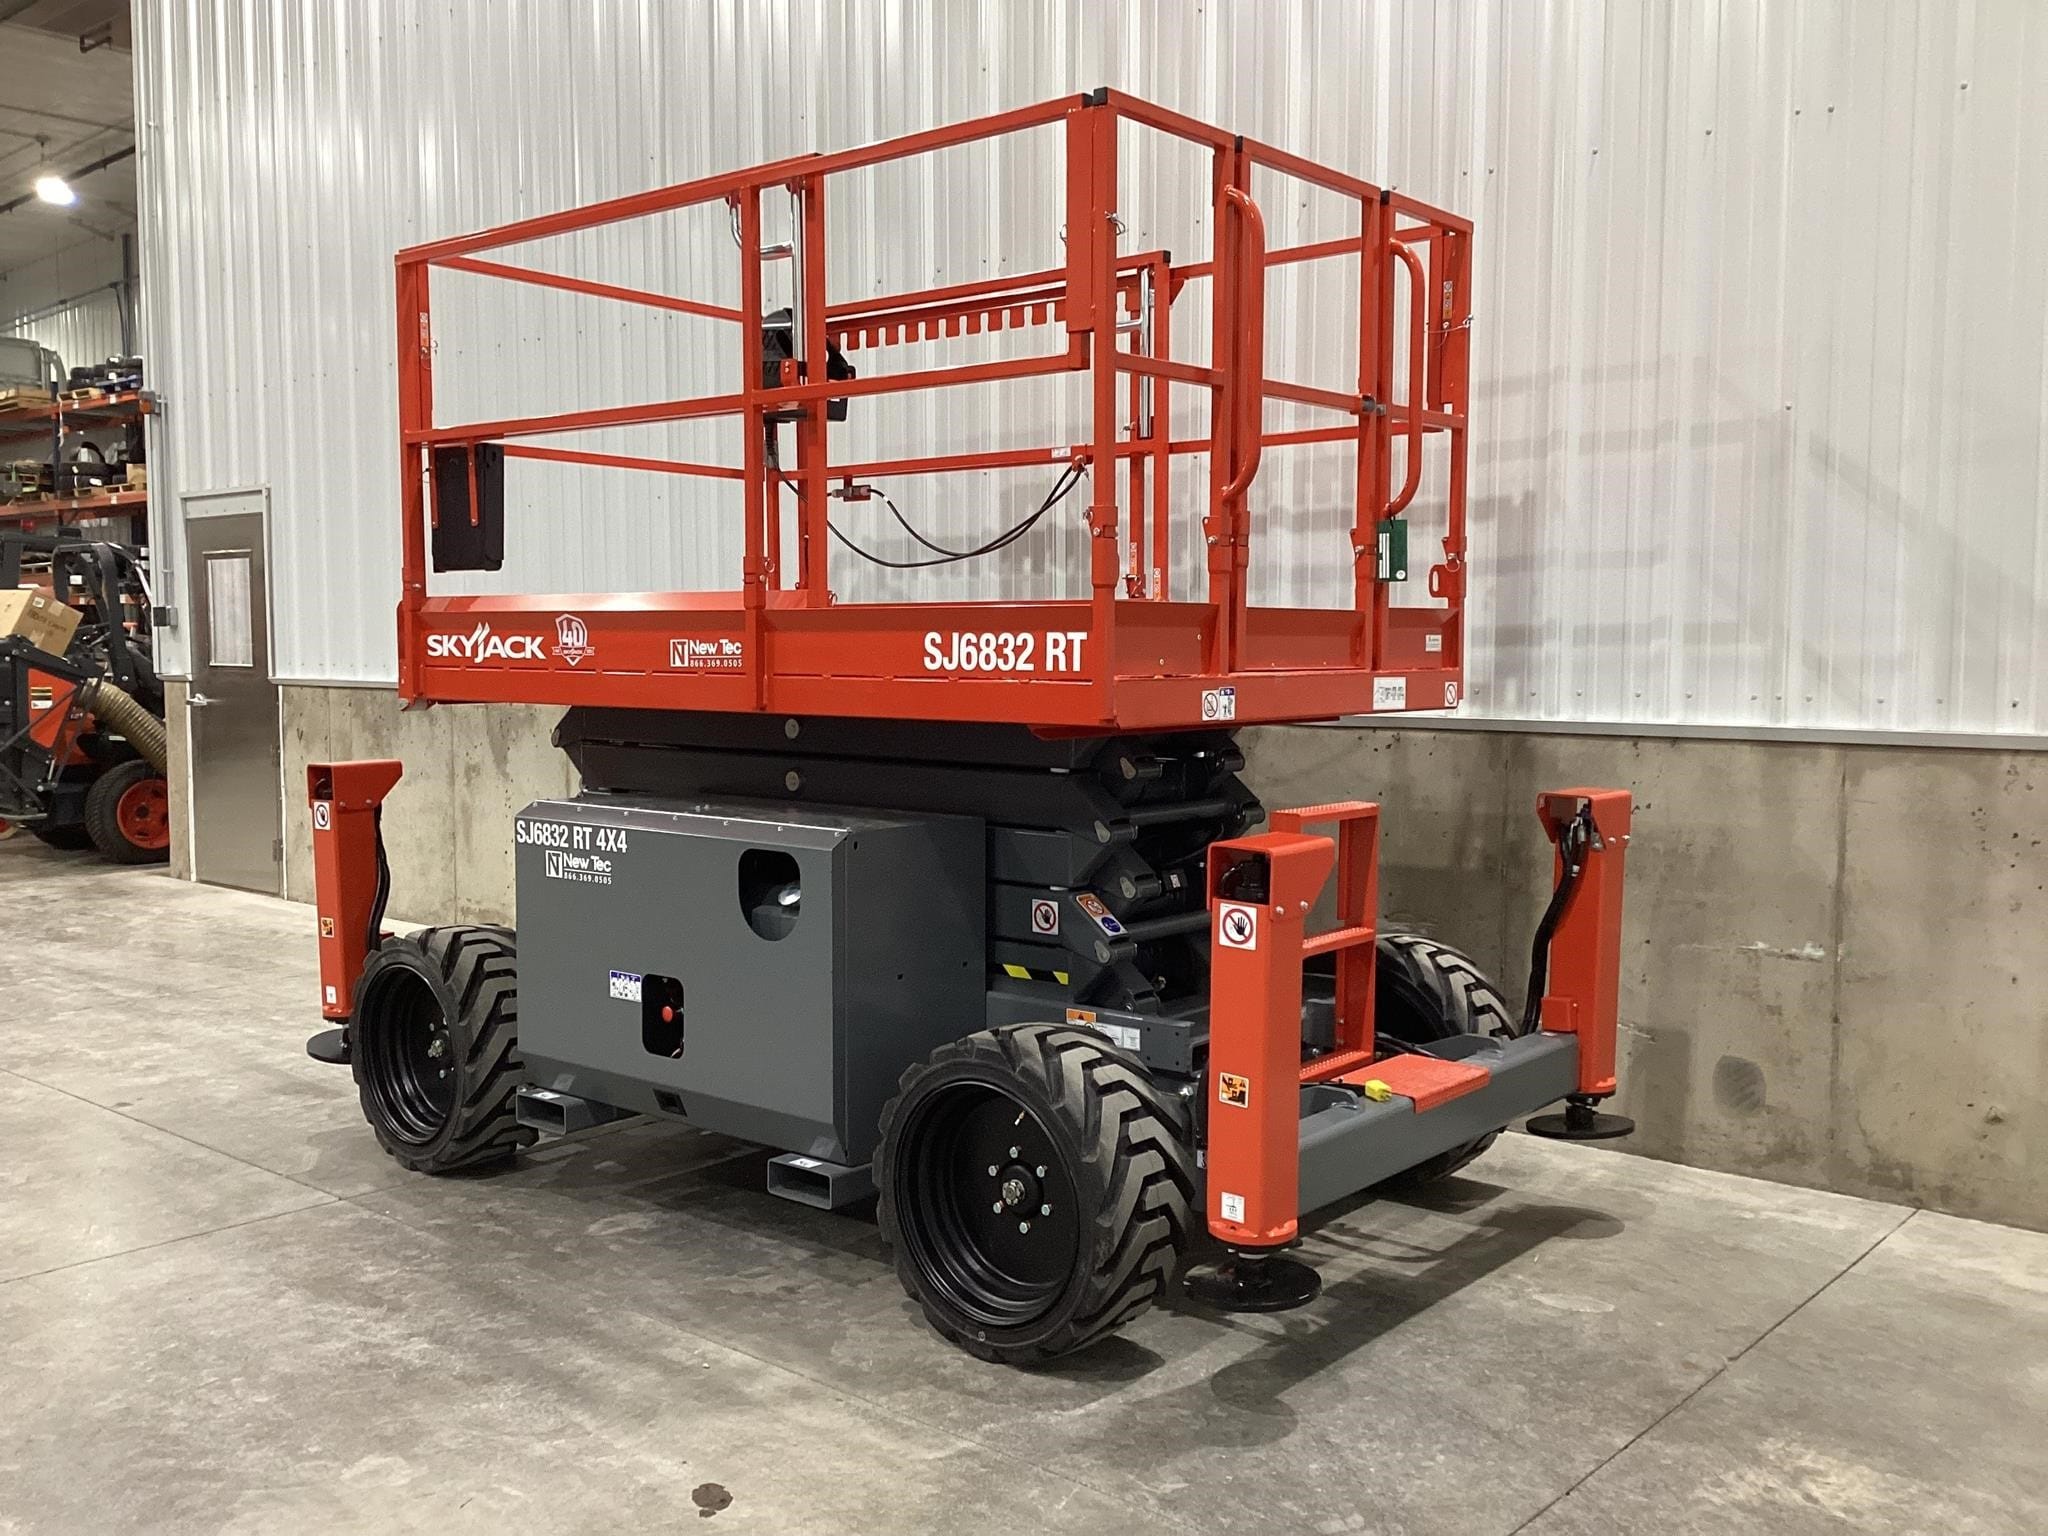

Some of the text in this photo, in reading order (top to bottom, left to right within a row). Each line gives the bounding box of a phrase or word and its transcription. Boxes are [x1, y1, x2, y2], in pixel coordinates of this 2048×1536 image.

[426, 621, 547, 664] SKYJACK
[689, 639, 743, 655] New Tec
[923, 631, 1088, 672] SJ6832 RT
[689, 659, 743, 668] 866.369.0505
[516, 819, 628, 853] SJ6832 RT 4X4
[563, 852, 612, 873] New Tec
